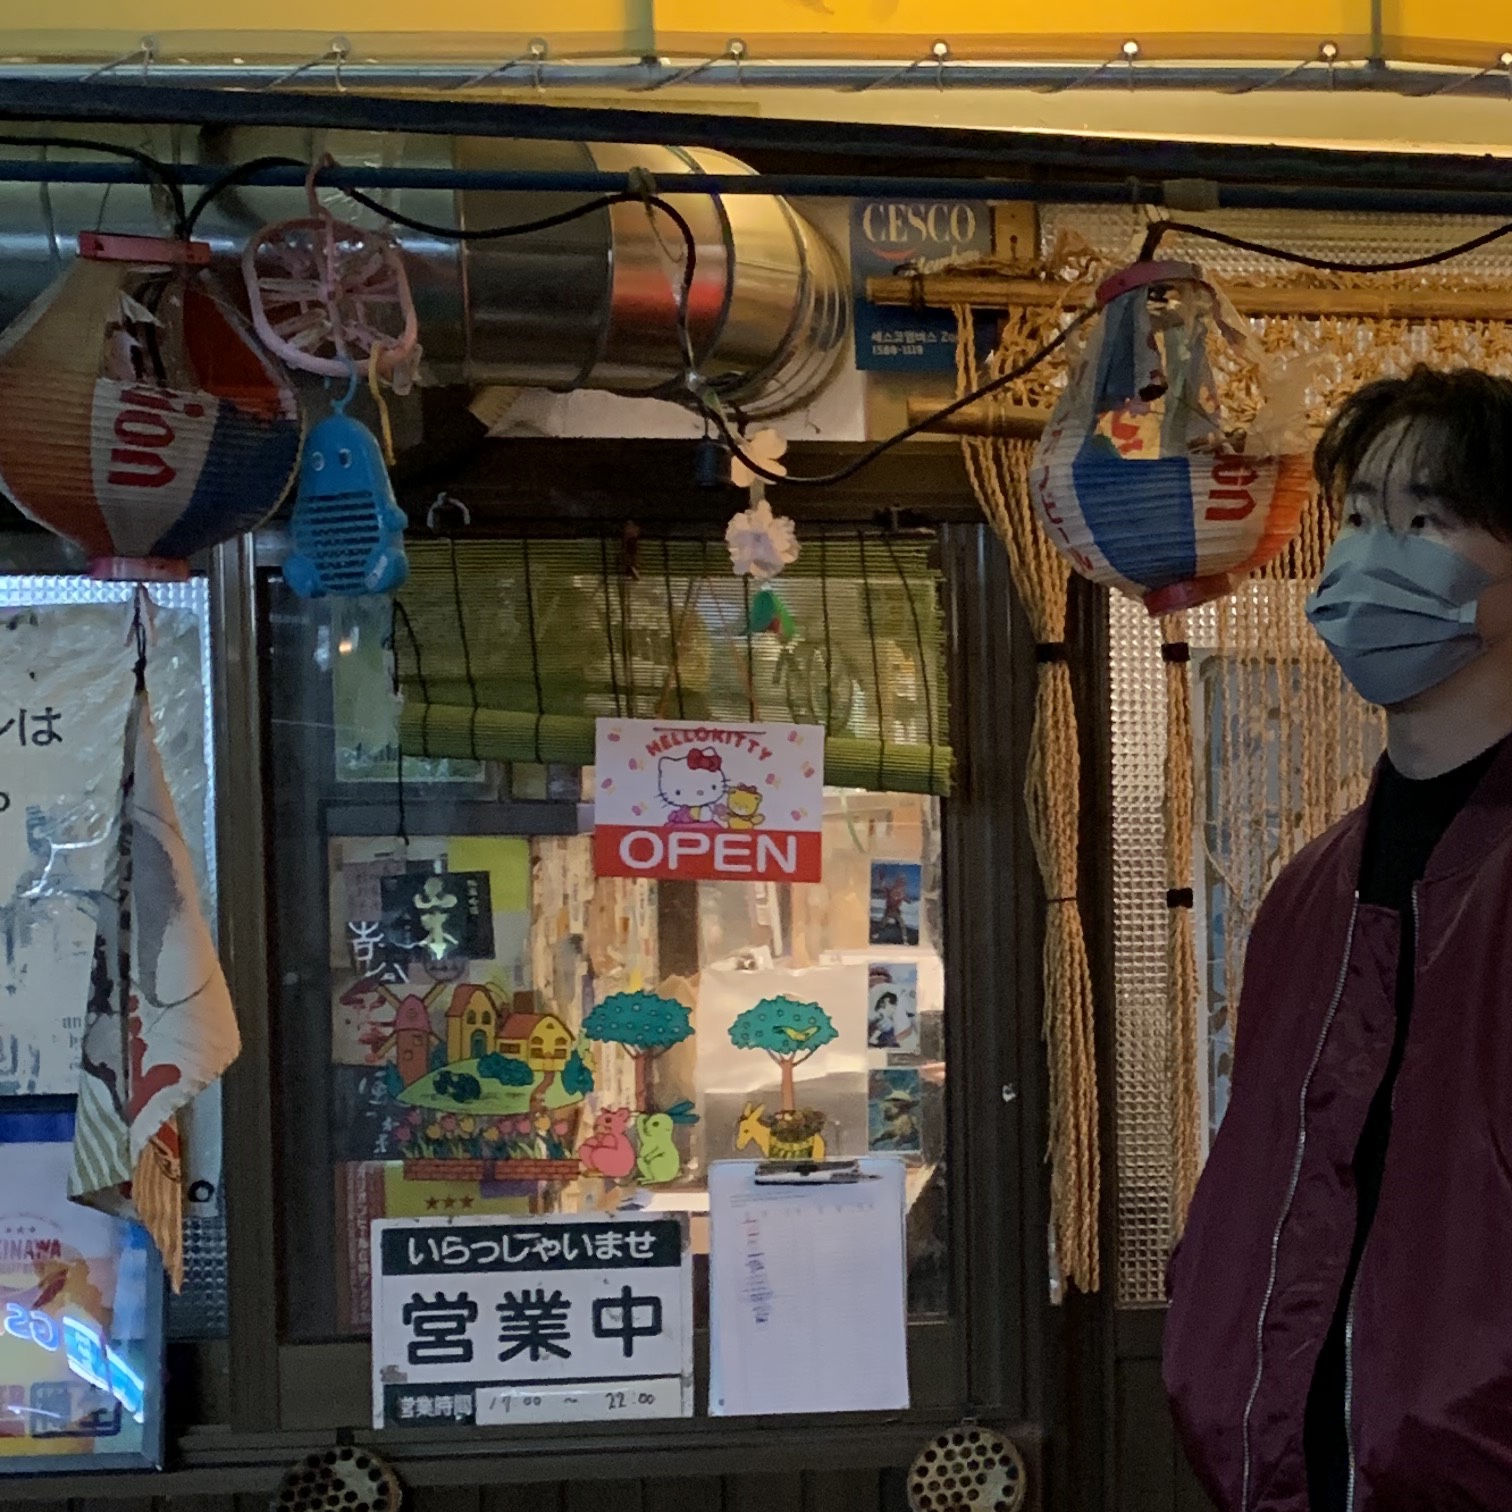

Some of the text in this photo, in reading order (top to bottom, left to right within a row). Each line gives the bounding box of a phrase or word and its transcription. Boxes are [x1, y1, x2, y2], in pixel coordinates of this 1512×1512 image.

[862, 203, 976, 243] CESCO
[619, 830, 797, 874] OPEN
[0, 1238, 62, 1260] INAWA
[406, 1230, 657, 1266] いらっしゃいませ
[402, 1284, 663, 1366] 営業中
